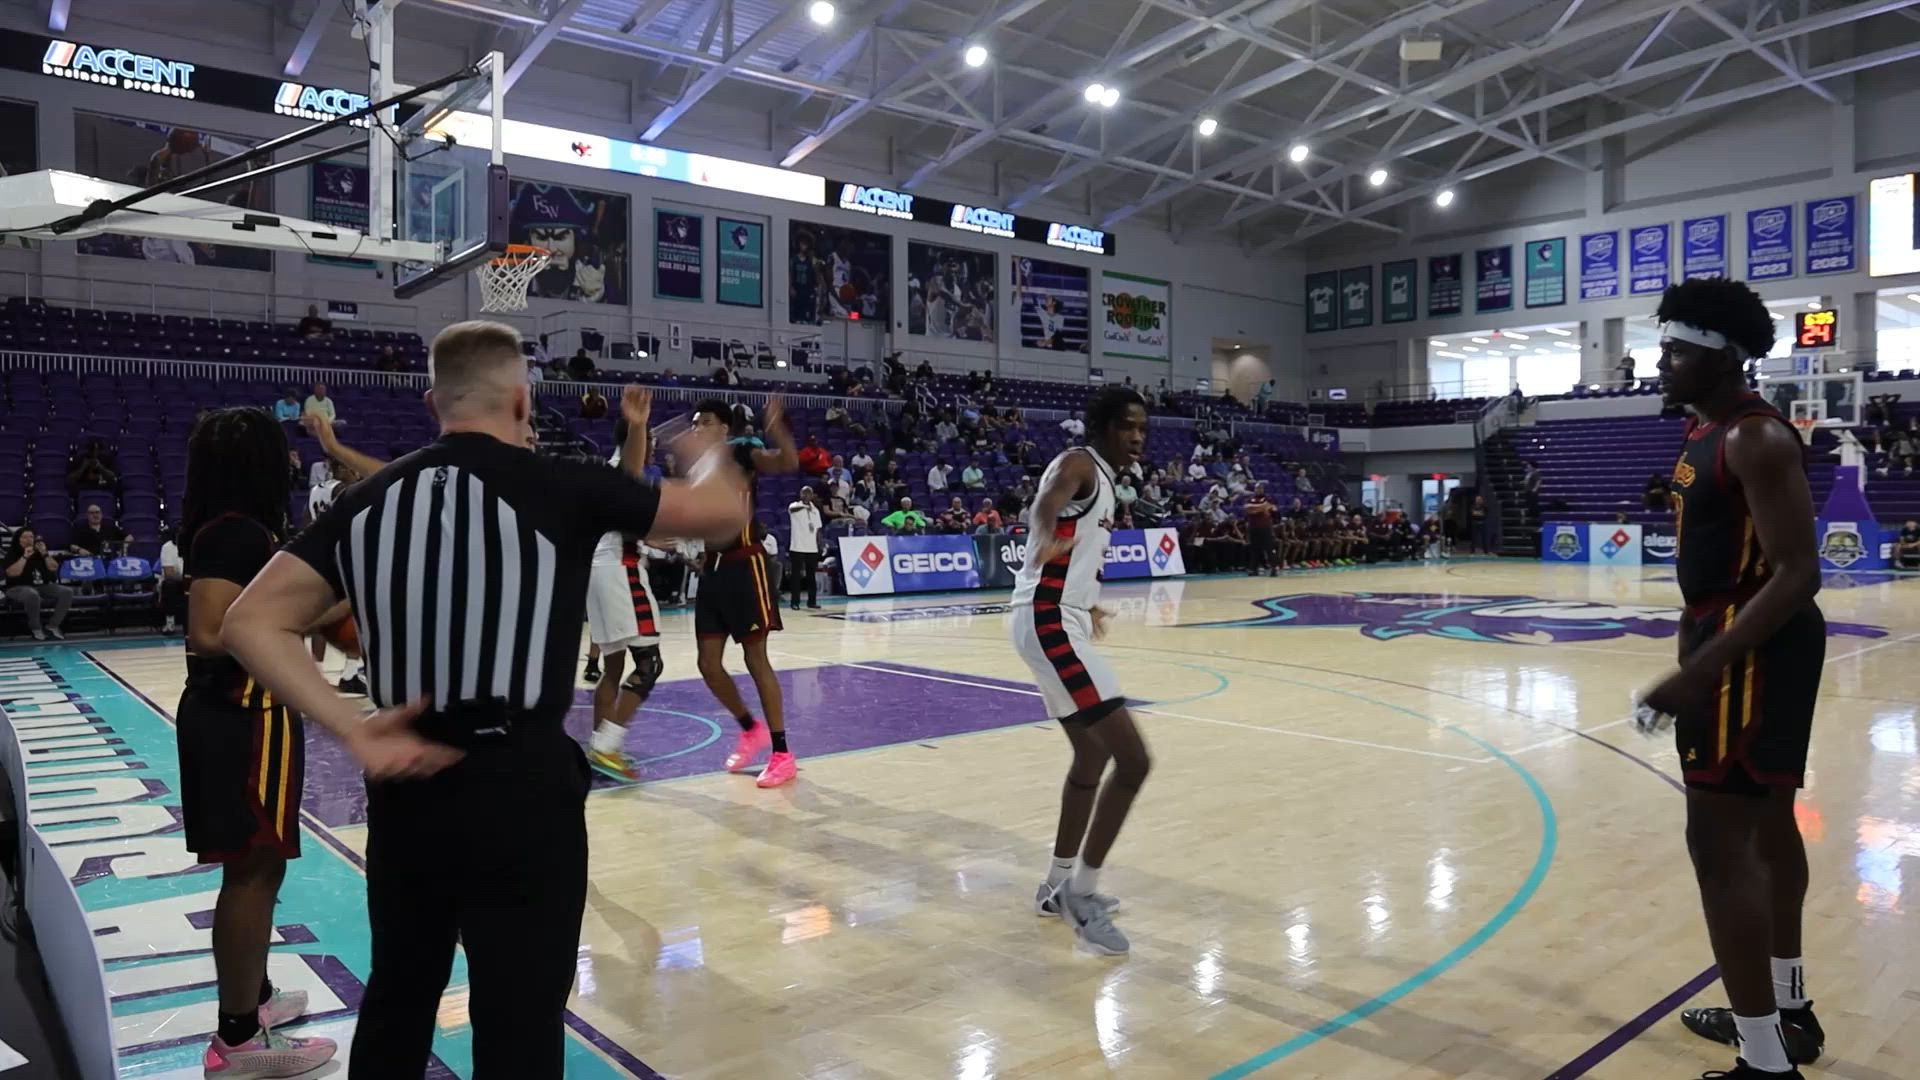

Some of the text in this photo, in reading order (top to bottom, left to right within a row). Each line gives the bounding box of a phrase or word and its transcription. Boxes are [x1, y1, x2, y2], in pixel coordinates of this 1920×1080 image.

[73, 46, 194, 87] ACCENT
[43, 64, 194, 99] business products
[275, 104, 335, 121] business
[533, 194, 560, 218] FSW
[855, 186, 913, 212] ACCENT
[963, 206, 1015, 230] ACCENT
[1060, 225, 1104, 247] ACCENT
[1752, 263, 1788, 276] 2023
[1811, 256, 1849, 270] 2025
[1106, 310, 1160, 330] ROOFING
[1801, 325, 1830, 345] 24
[1001, 540, 1026, 563] ale
[1643, 533, 1677, 548] alex
[893, 552, 973, 574] GEICO
[1103, 545, 1147, 563] EICO
